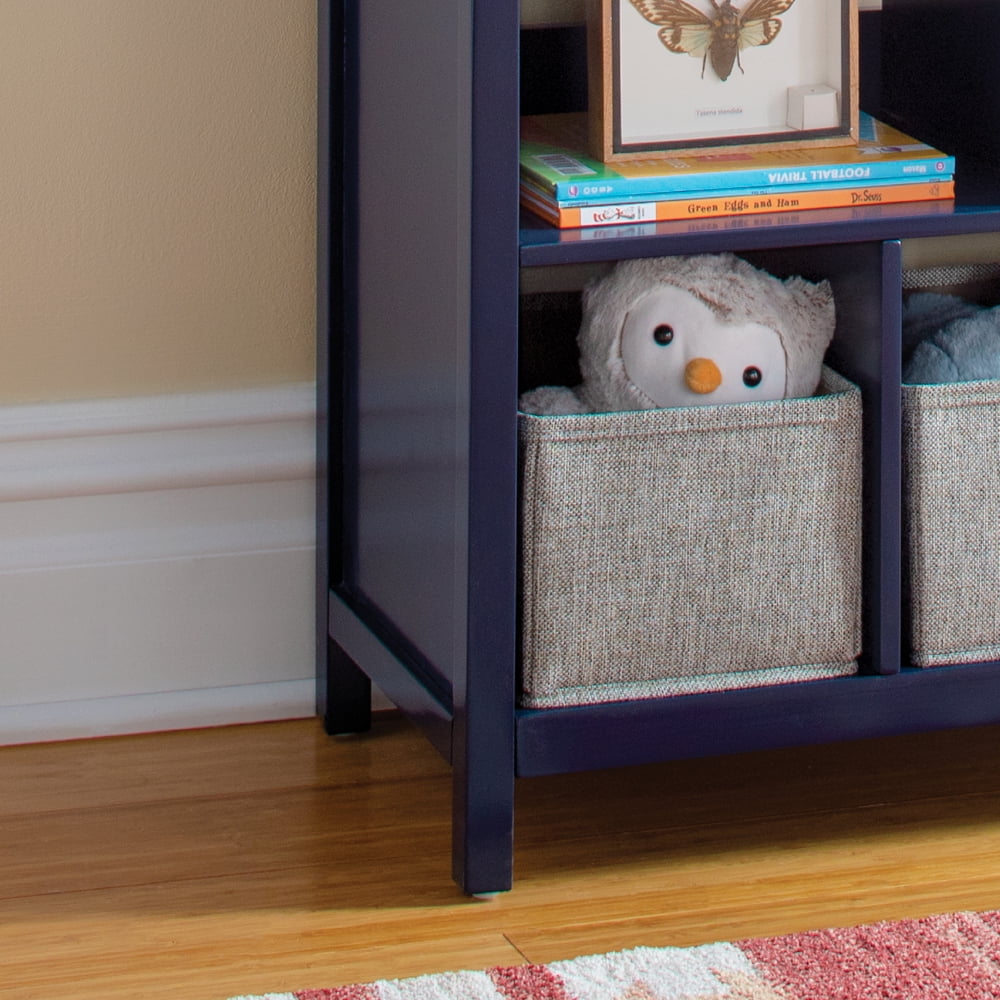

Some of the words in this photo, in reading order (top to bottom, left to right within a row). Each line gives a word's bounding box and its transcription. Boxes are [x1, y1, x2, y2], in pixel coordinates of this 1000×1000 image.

[768, 169, 808, 183] TRIVIA
[808, 166, 870, 181] FOOTBALL
[863, 190, 883, 203] Seuss
[687, 203, 718, 214] Green
[724, 199, 749, 213] Eggs
[754, 198, 773, 208] and
[777, 197, 800, 208] Ham
